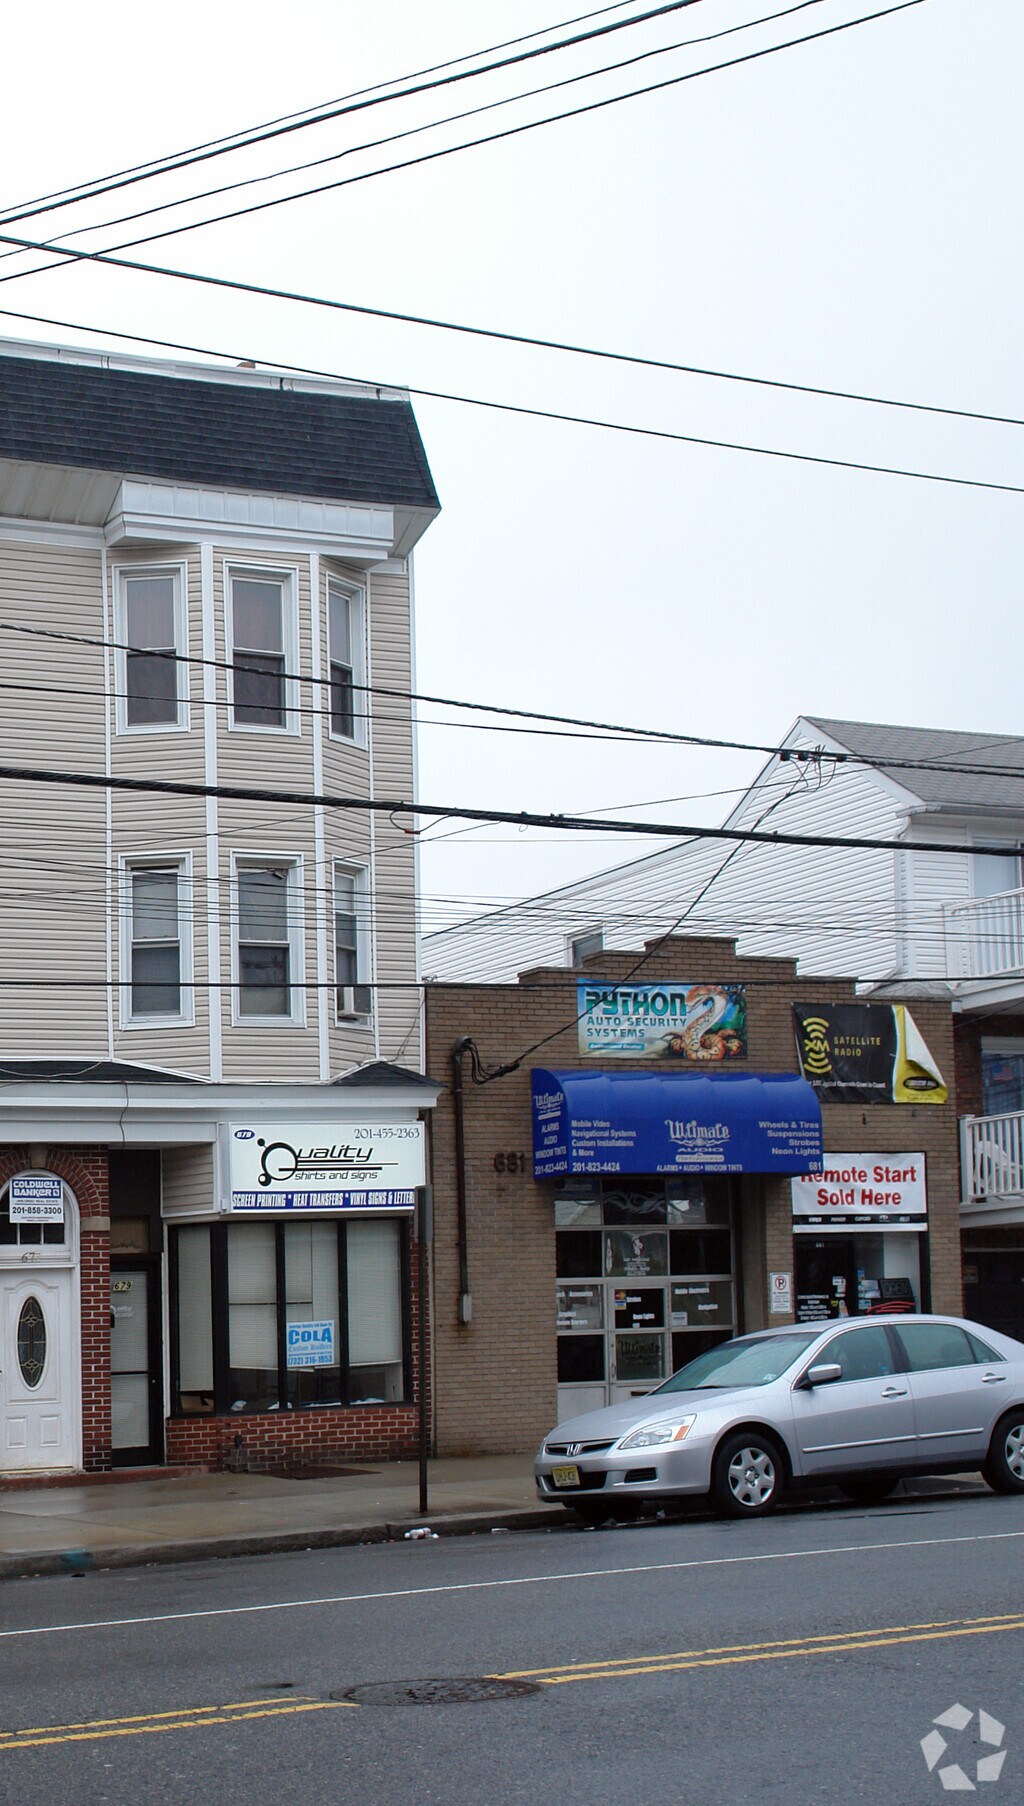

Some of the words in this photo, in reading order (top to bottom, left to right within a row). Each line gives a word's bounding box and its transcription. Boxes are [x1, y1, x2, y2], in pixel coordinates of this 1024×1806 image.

[586, 991, 687, 1016] PYTHON
[587, 1016, 622, 1026] AUTO
[627, 1017, 687, 1027] SECURITY
[587, 1028, 645, 1038] SYSTEMS
[542, 1122, 560, 1133] ALARMS
[571, 1120, 592, 1128] Mobile
[664, 1119, 731, 1139] Ultimate
[758, 1121, 789, 1129] Wheels
[354, 1128, 420, 1139] 201-455-2363
[571, 1130, 609, 1139] Navigational
[610, 1130, 636, 1138] Systems
[767, 1130, 820, 1138] Suspensions
[544, 1135, 558, 1145] AUDIO
[536, 1149, 554, 1160] WINDOW
[772, 1147, 793, 1155] Neon
[795, 1147, 821, 1156] Lights
[494, 1151, 525, 1173] 681
[572, 1162, 621, 1172] 201-823-4424
[808, 1162, 822, 1171] 681
[535, 1161, 568, 1175] 201-823-4424
[656, 1164, 678, 1172] ALARMS
[683, 1164, 701, 1172] AUDIO
[704, 1164, 727, 1172] WINDOW
[295, 1170, 326, 1180] shirts
[329, 1170, 349, 1180] and
[351, 1169, 378, 1182] signs
[873, 1165, 917, 1183] Start
[13, 1180, 60, 1189] COLDWELL
[14, 1188, 52, 1197] BANKER
[817, 1188, 855, 1206] Sold
[861, 1189, 902, 1205] Here
[232, 1194, 255, 1207] SCREEN
[257, 1194, 287, 1207] PRINTING
[293, 1193, 308, 1206] HEAT
[309, 1193, 344, 1206] TRANSFERS
[350, 1192, 367, 1205] VINYL
[368, 1192, 387, 1205] SIGNS
[12, 1206, 62, 1215] 201-858-3300
[114, 1281, 132, 1290] 679
[288, 1327, 332, 1345] COLA
